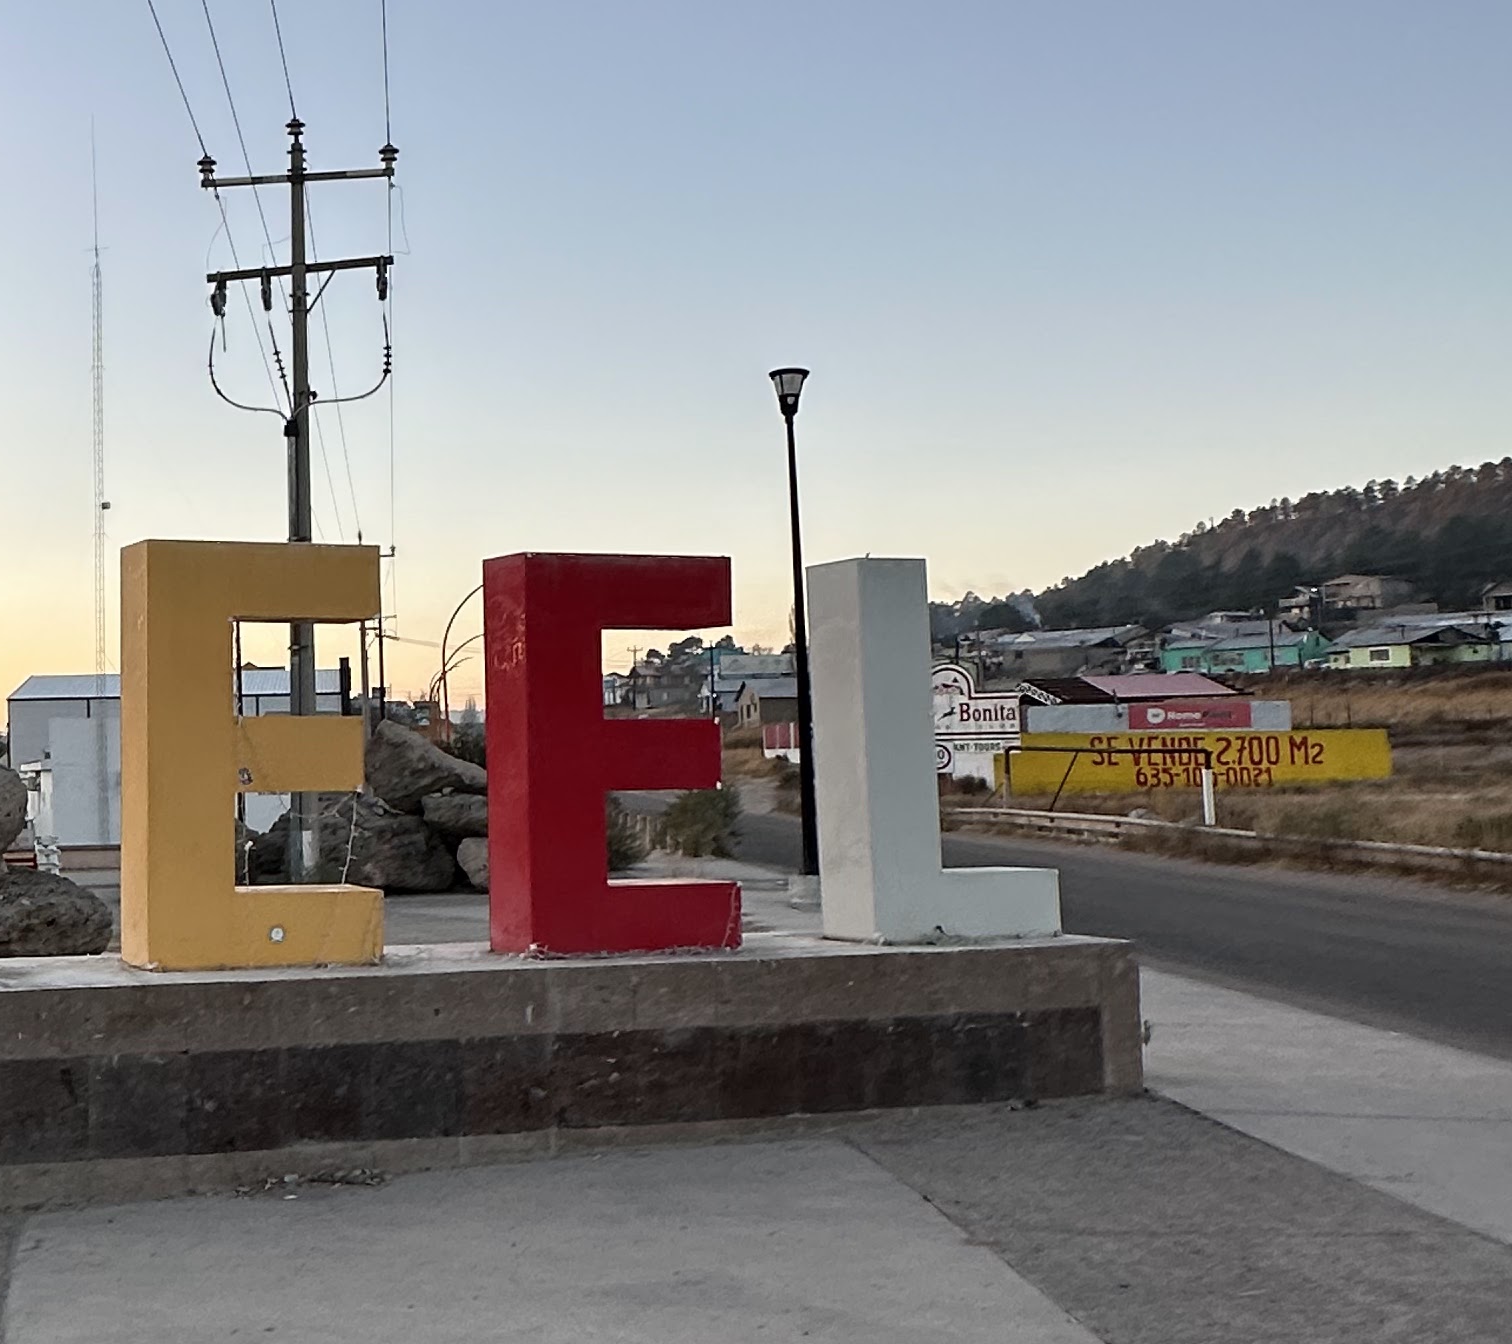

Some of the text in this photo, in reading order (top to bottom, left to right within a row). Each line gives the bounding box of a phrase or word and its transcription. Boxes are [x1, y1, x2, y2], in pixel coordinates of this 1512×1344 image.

[958, 702, 1017, 722] Bonita
[1089, 736, 1120, 766] SE
[1128, 736, 1206, 766] VENDE
